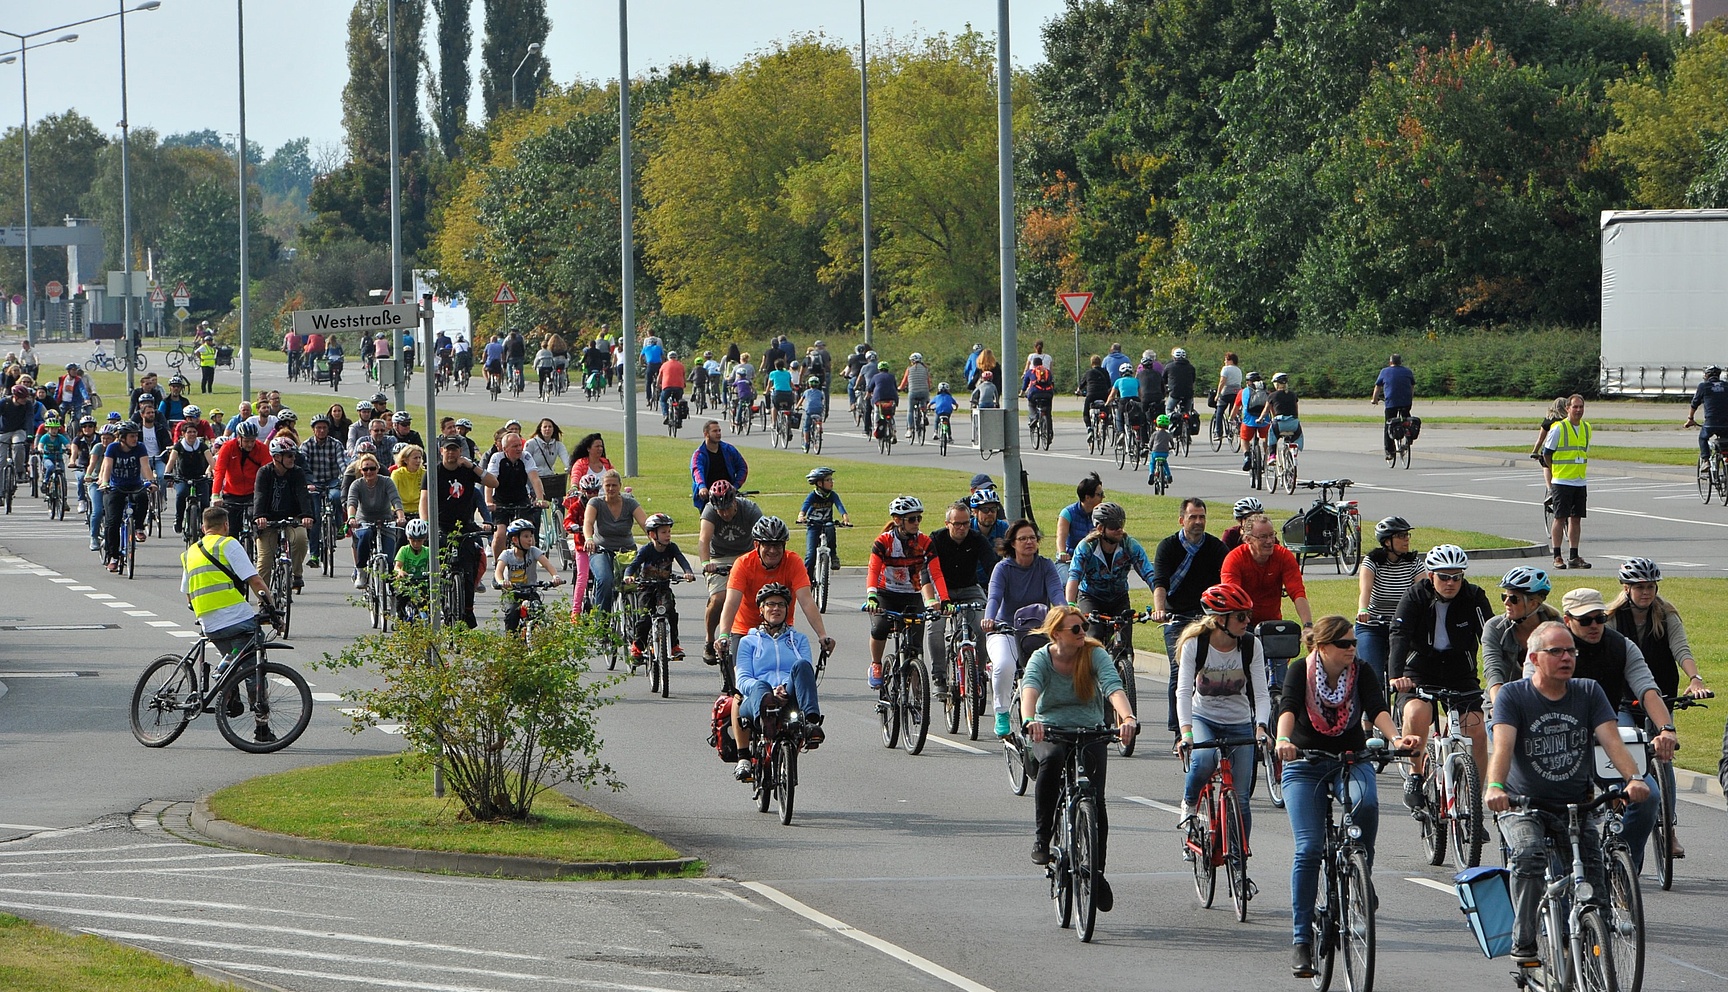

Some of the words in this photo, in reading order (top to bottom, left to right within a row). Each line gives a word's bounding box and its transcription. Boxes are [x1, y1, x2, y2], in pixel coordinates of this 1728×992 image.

[311, 309, 402, 329] Weststraße
[1540, 712, 1560, 722] QUALITY
[1560, 713, 1578, 725] GOODS
[1543, 722, 1570, 735] OFFICIAL
[1523, 733, 1567, 757] DENIM
[1570, 727, 1588, 747] CO
[1531, 761, 1543, 774] HIGH
[1541, 771, 1569, 781] STANDARD
